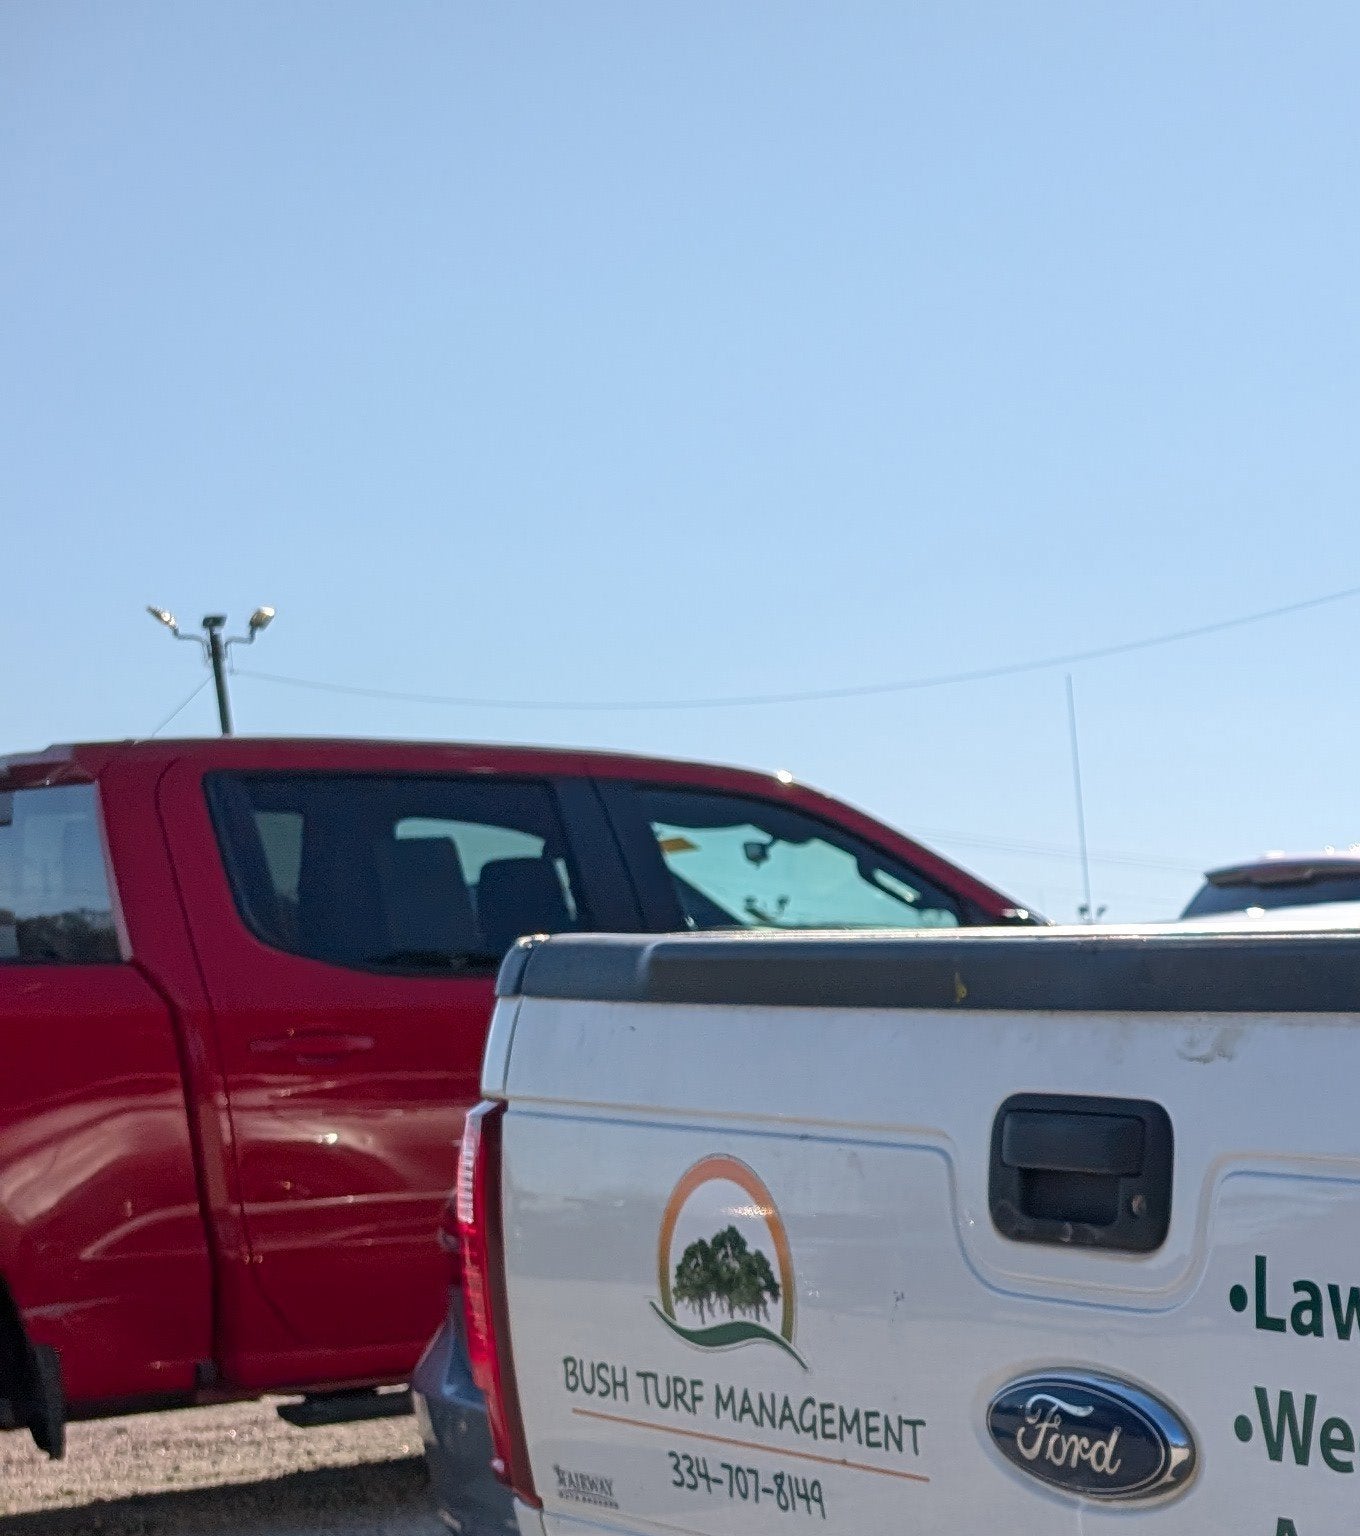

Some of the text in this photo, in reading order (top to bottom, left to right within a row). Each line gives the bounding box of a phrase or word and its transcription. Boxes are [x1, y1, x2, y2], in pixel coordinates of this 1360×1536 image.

[562, 1355, 927, 1456] BUSH TURF MANAGEMENT
[1015, 1393, 1123, 1476] Ford
[667, 1450, 827, 1521] 334-707-8149
